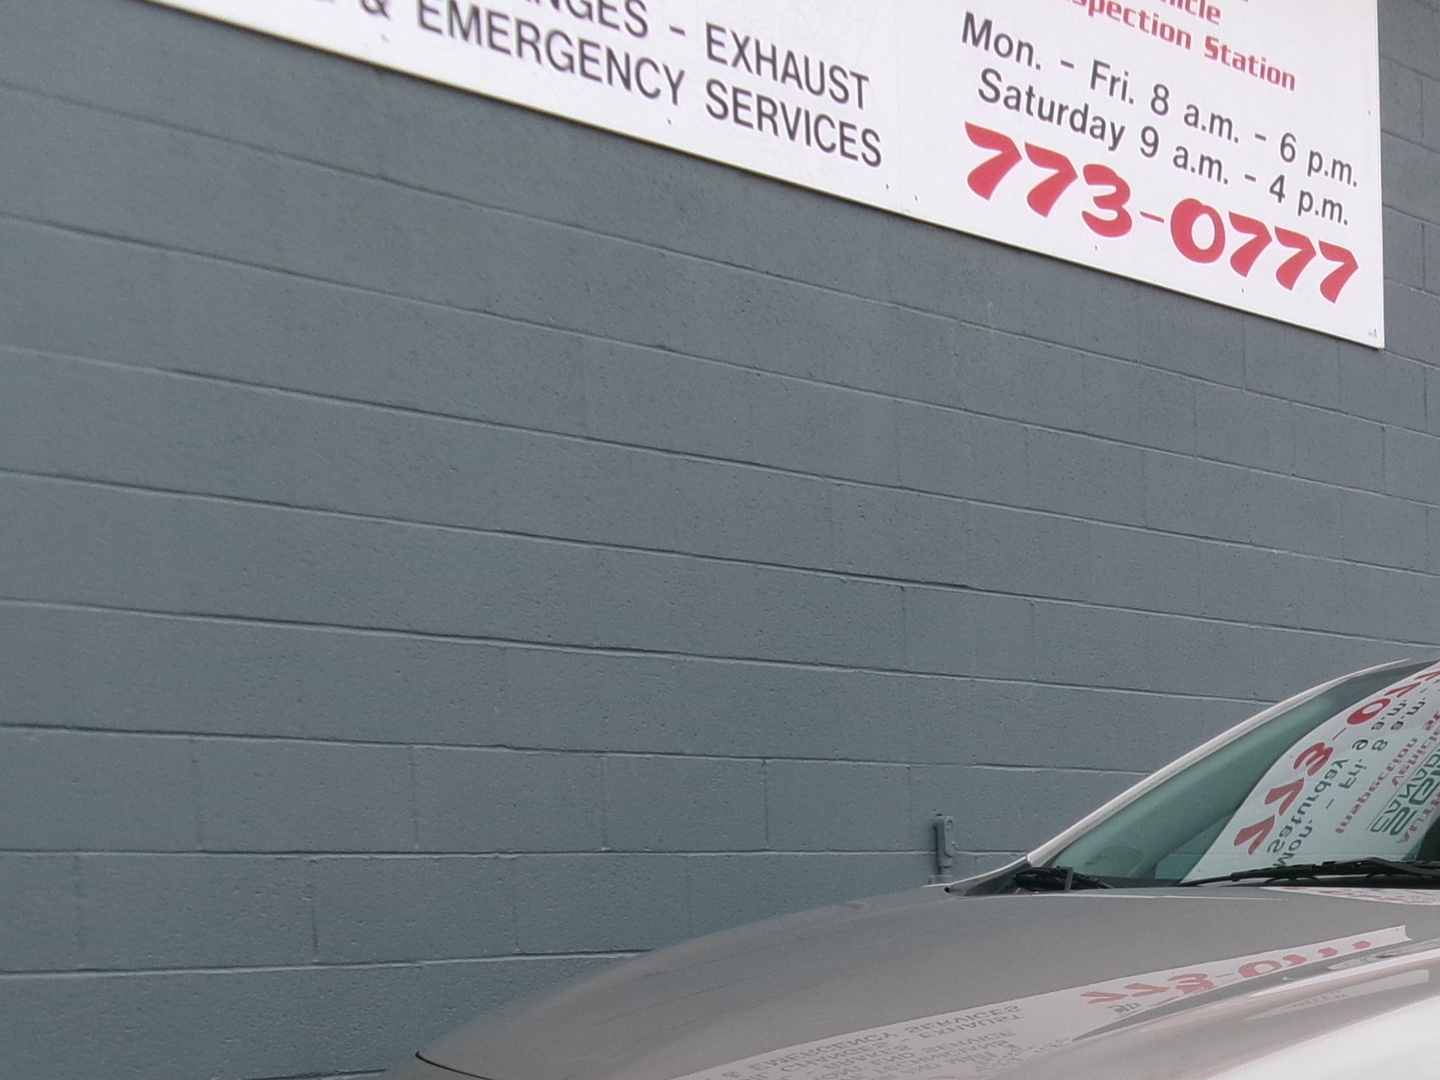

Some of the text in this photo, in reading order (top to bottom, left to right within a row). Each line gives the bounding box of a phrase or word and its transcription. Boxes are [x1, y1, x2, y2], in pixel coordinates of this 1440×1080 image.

[417, 0, 686, 105] EMERGENCY
[704, 79, 883, 168] SERVICES
[704, 22, 870, 110] EXHAUST
[961, 12, 1042, 71] Mon.
[1089, 59, 1135, 104] Fri.
[1149, 83, 1171, 116] 8
[1183, 101, 1240, 144] a.m.
[1278, 132, 1298, 163] 6
[1307, 150, 1359, 188] p.m.
[1204, 35, 1297, 91] Station
[964, 121, 1360, 304] 773-0777
[978, 68, 1126, 152] Saturday
[1138, 126, 1160, 158] 9
[1172, 143, 1230, 185] a.m.
[1267, 174, 1286, 204] 4
[1297, 188, 1350, 226] p.m.
